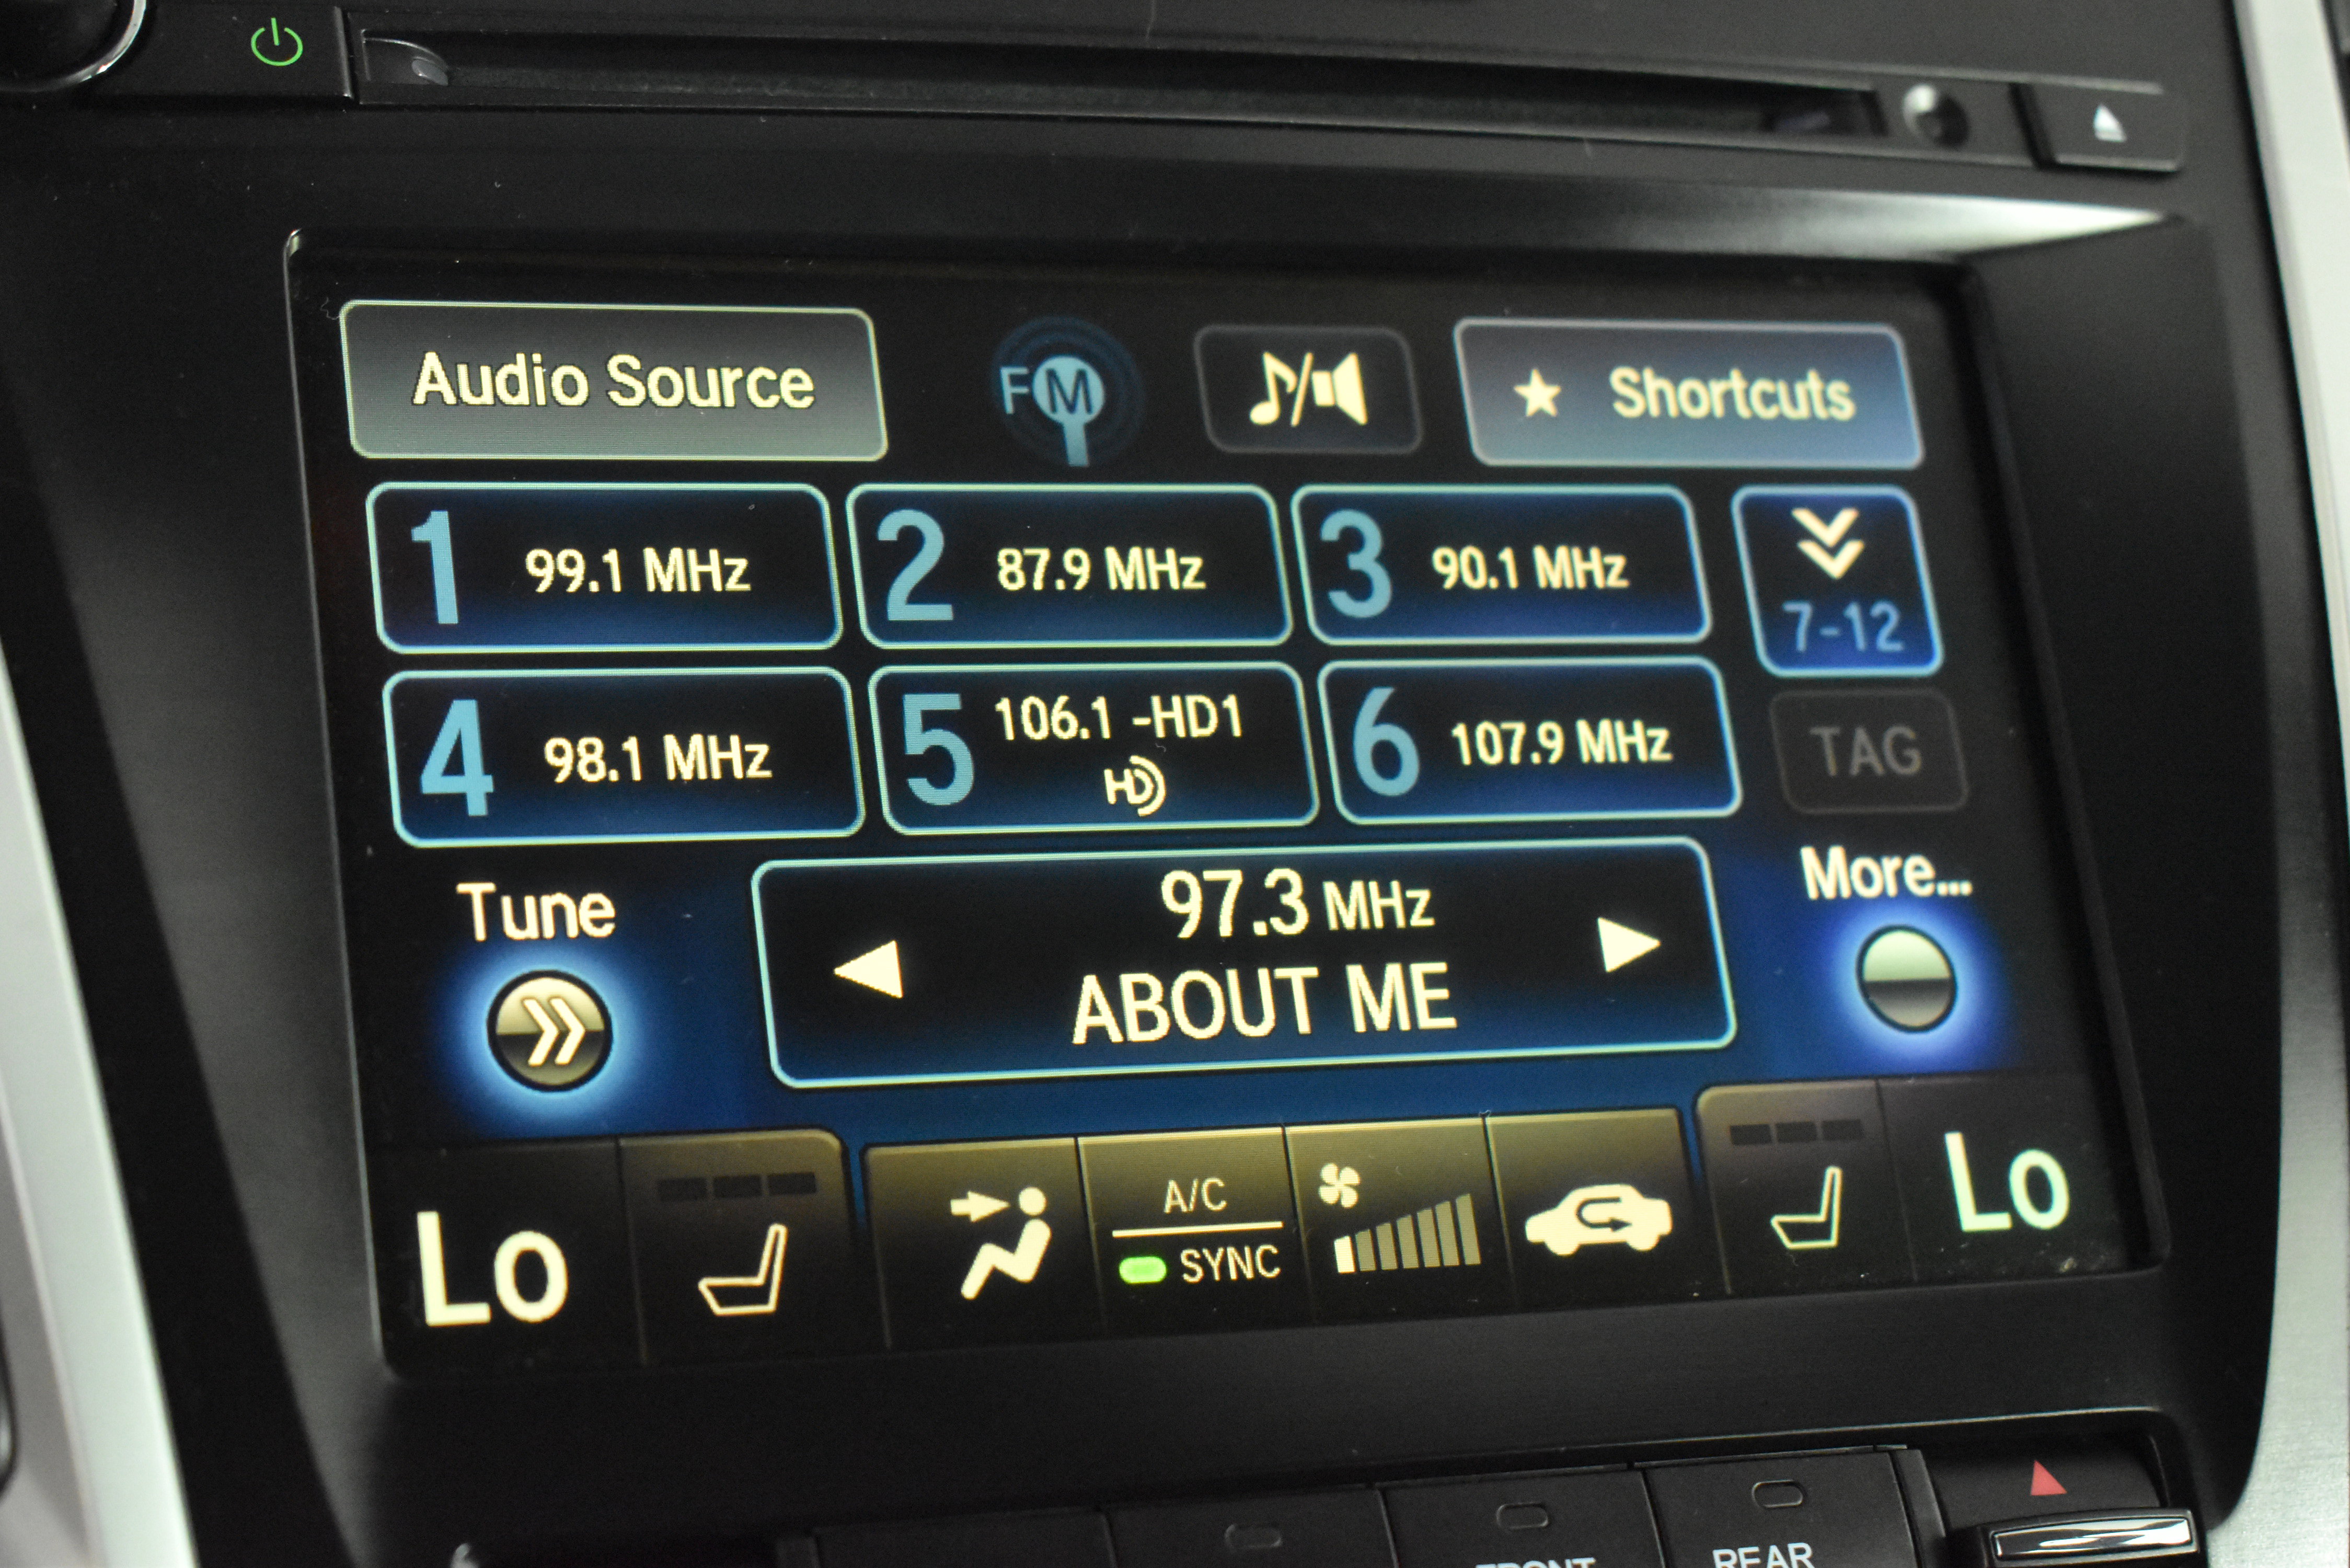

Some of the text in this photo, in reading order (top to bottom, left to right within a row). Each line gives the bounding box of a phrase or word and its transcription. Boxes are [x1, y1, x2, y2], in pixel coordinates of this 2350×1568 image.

[413, 351, 814, 408] Audio Source
[999, 361, 1101, 418] FM
[1610, 367, 1856, 421] Shortcuts
[411, 510, 459, 625] 1
[525, 547, 751, 593] 99.1 MHz
[877, 509, 953, 621] 2
[997, 546, 1206, 591] 87.9 MHz
[1319, 509, 1392, 618] 3
[1432, 545, 1629, 589] 90.1 MHz
[1782, 601, 1905, 652] 7-12
[995, 694, 1242, 741] 106.1 -HD1
[1353, 687, 1419, 797] 6
[1452, 719, 1673, 765] 107.9 MHz
[420, 699, 494, 816] 4
[544, 733, 772, 783] 98.1 MHz
[903, 693, 974, 806] 5
[1810, 725, 1922, 776] TAG
[1799, 845, 1974, 900] More...
[456, 882, 616, 942] Tune
[1161, 868, 1435, 939] 97.3 MHz
[1072, 962, 1457, 1045] ABOUT ME
[1164, 1177, 1227, 1214] A/C
[1944, 1132, 2069, 1232] Lo
[417, 1211, 568, 1327] Lo
[1180, 1244, 1281, 1283] SYNC
